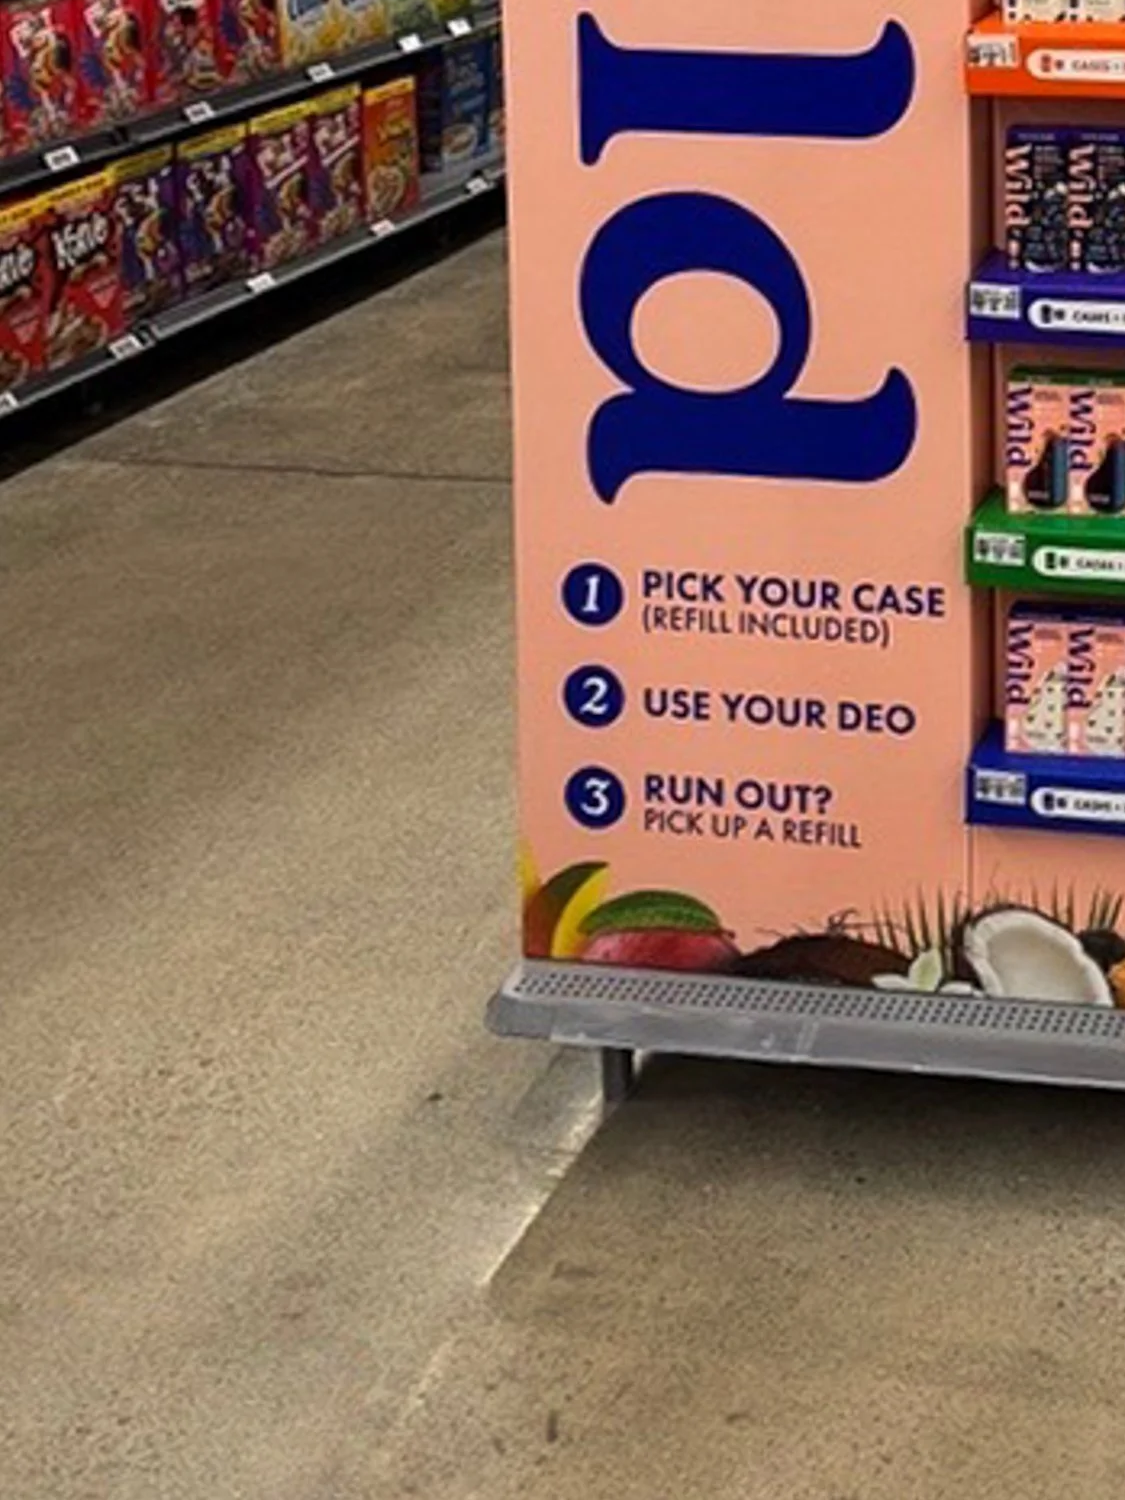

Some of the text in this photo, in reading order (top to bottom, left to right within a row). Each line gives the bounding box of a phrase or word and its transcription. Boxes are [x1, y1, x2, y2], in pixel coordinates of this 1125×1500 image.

[1005, 143, 1033, 226] Wild
[1068, 144, 1096, 228] Wild
[1006, 384, 1034, 467] Wild
[1069, 387, 1097, 470] Wild
[581, 575, 601, 614] 1
[642, 569, 947, 618] PICK YOUR CASE
[642, 604, 892, 649] (REFILL INCLUDED)
[1007, 623, 1035, 705] Wild
[1068, 628, 1096, 709] Wild
[579, 676, 610, 716] 2
[643, 687, 917, 735] USE YOUR DEO
[579, 776, 611, 817] 3
[643, 773, 834, 815] RUN OUT?
[643, 808, 863, 849] PICK UP A REFILL
